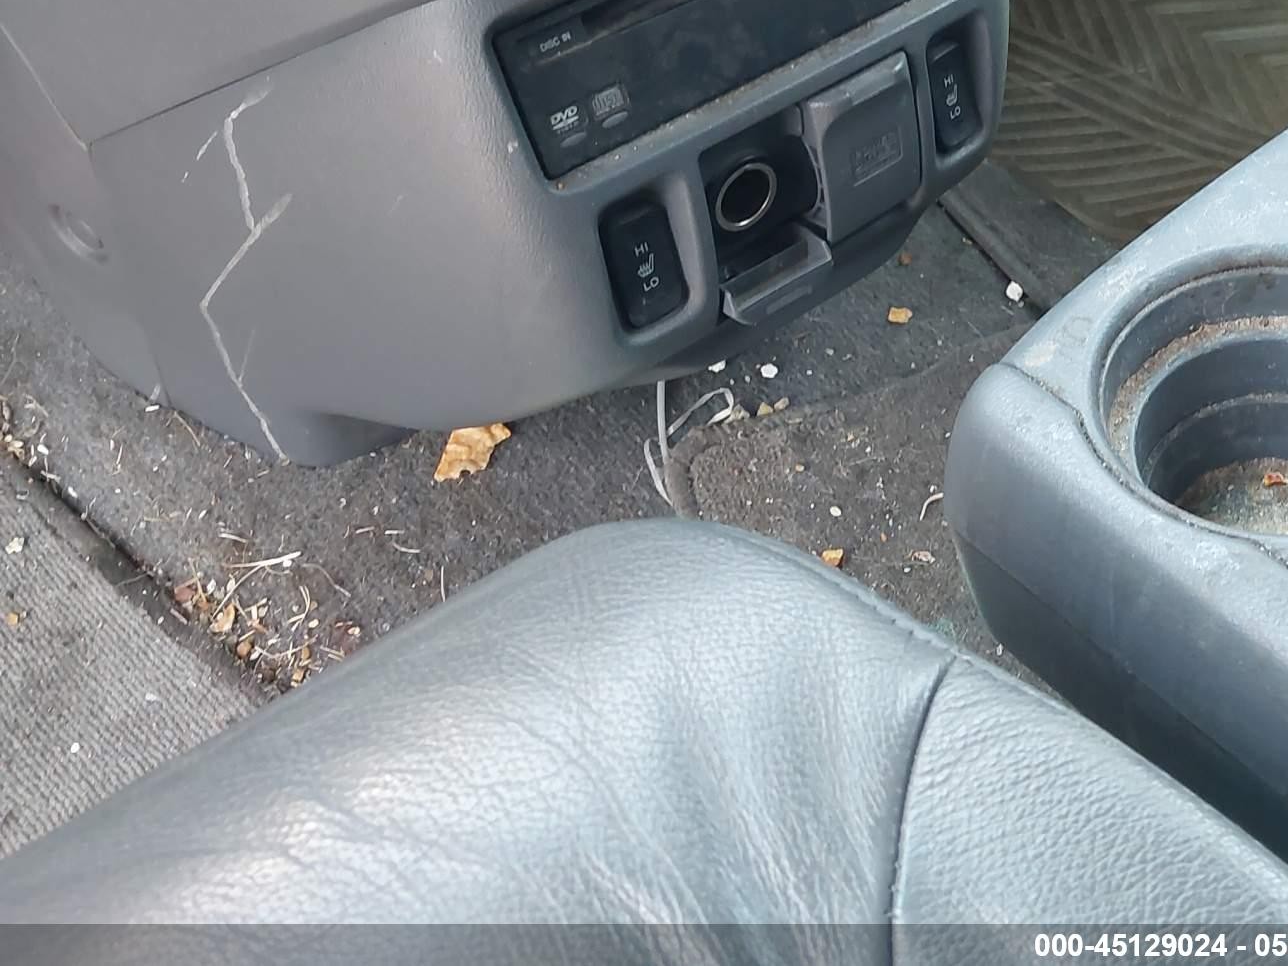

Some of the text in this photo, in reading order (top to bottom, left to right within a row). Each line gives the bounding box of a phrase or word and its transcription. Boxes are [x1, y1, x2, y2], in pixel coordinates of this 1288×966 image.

[539, 36, 561, 53] DISC
[943, 73, 955, 88] HI
[550, 105, 579, 126] DVD
[949, 105, 962, 120] LO
[634, 241, 649, 257] HI
[643, 276, 660, 292] LO
